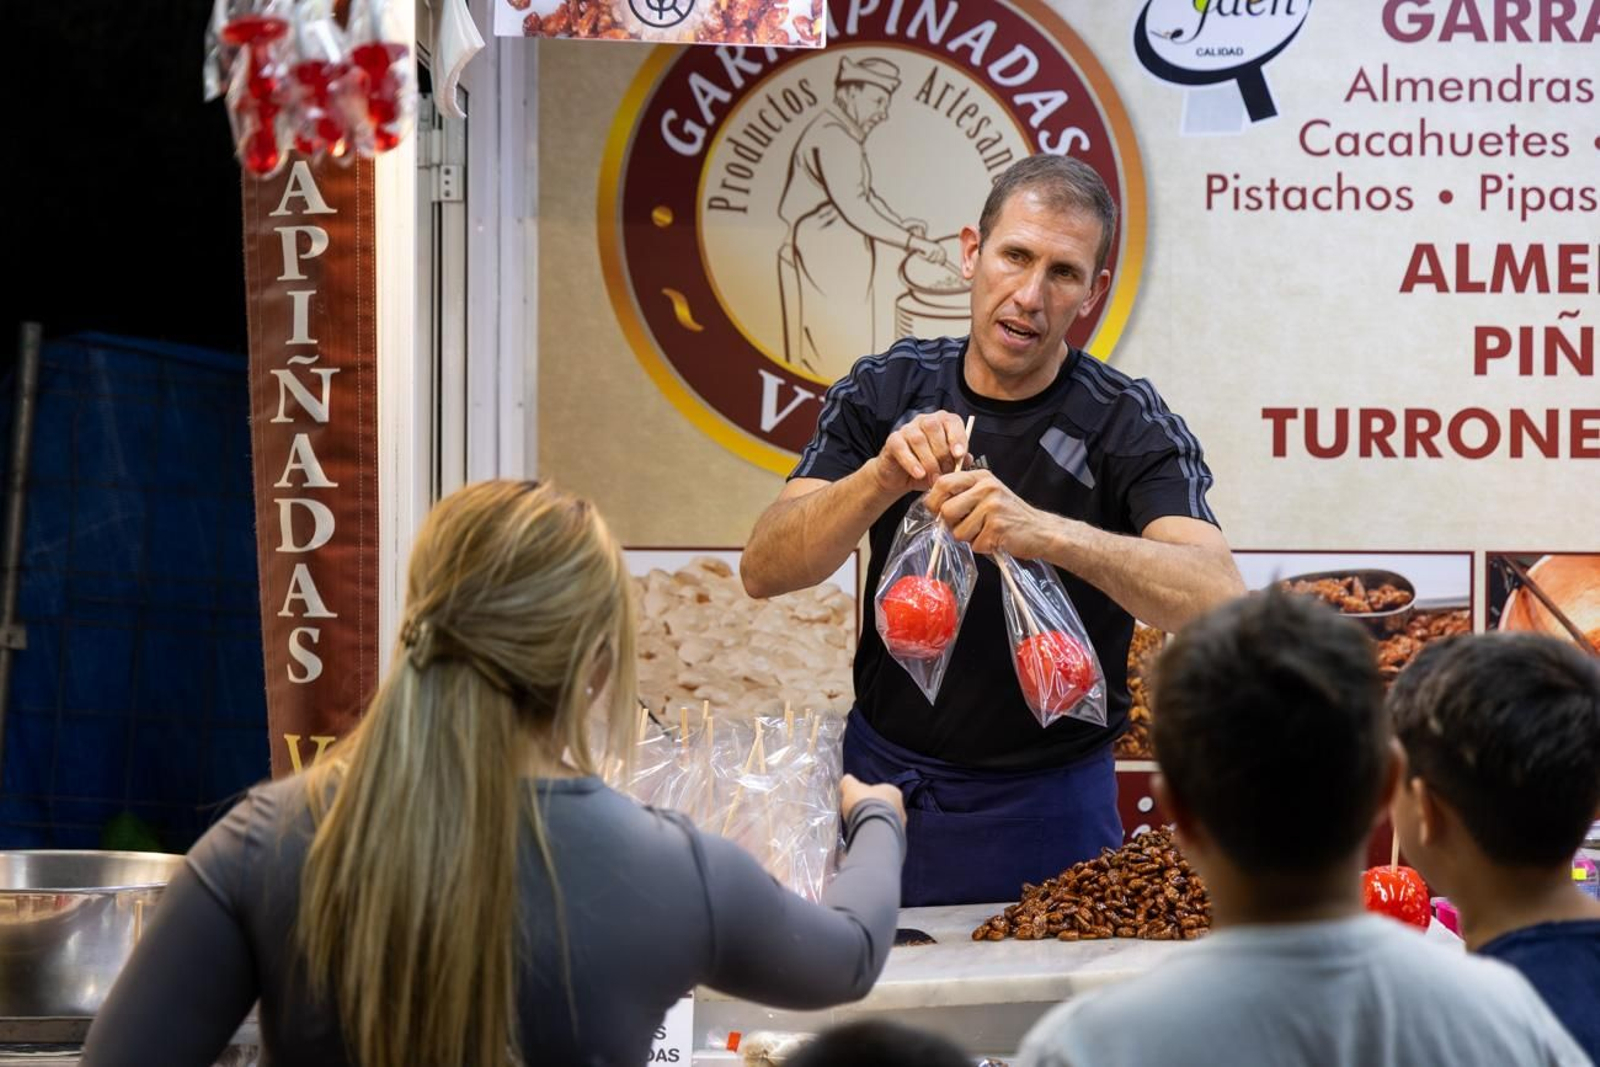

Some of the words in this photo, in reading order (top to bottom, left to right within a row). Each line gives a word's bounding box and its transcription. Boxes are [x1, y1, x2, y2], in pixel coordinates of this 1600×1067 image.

[1196, 47, 1244, 57] CALIDAD
[1345, 64, 1595, 103] Almendras
[707, 78, 818, 214] Productos
[915, 65, 1013, 188] Artesan
[1299, 118, 1570, 157] Cacahuetes
[1206, 172, 1414, 211] Pistachos
[1480, 174, 1598, 221] Pipas
[1400, 243, 1600, 293] ALME
[1474, 309, 1594, 376] PIÑ
[1262, 407, 1600, 459] TURRONE
